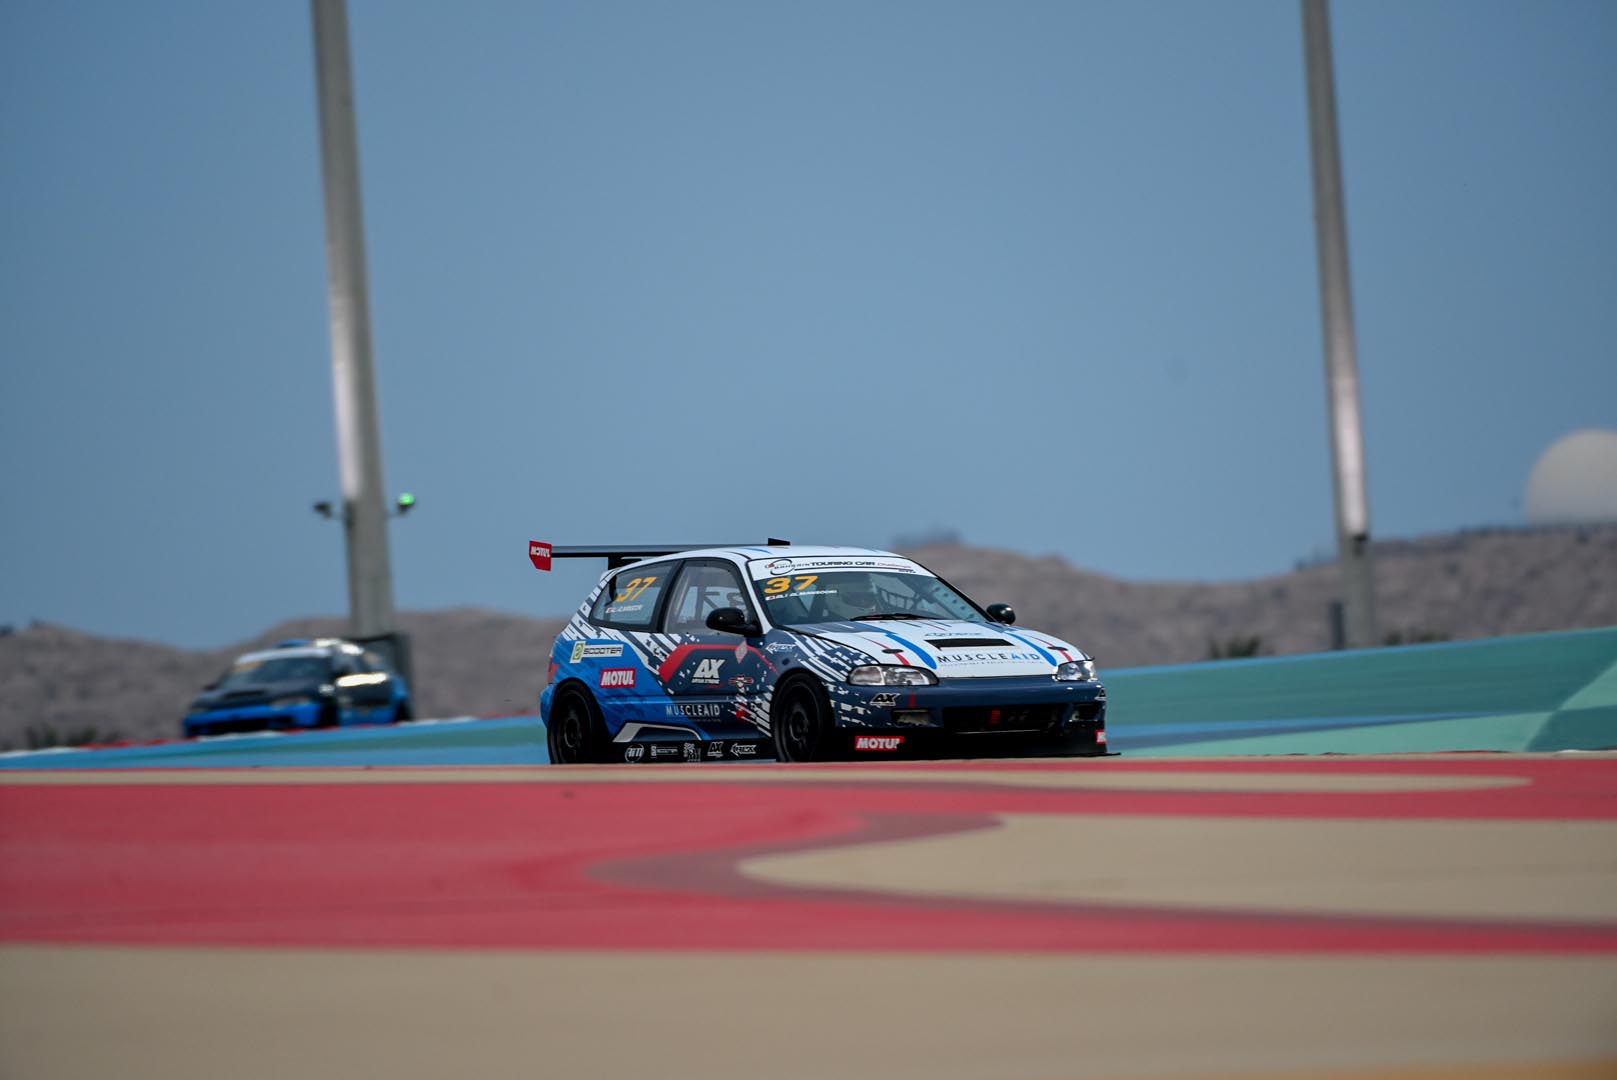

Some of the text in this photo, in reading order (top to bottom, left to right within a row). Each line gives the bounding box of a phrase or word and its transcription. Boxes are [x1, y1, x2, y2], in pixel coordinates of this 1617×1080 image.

[615, 576, 657, 602] 37
[764, 576, 818, 594] 37
[583, 646, 622, 655] SCOOTER
[936, 652, 1041, 663] MUSCLEAID
[692, 659, 726, 678] AX
[601, 670, 634, 686] MOTUL
[870, 692, 901, 706] AX
[665, 703, 720, 717] MUSCLEAID
